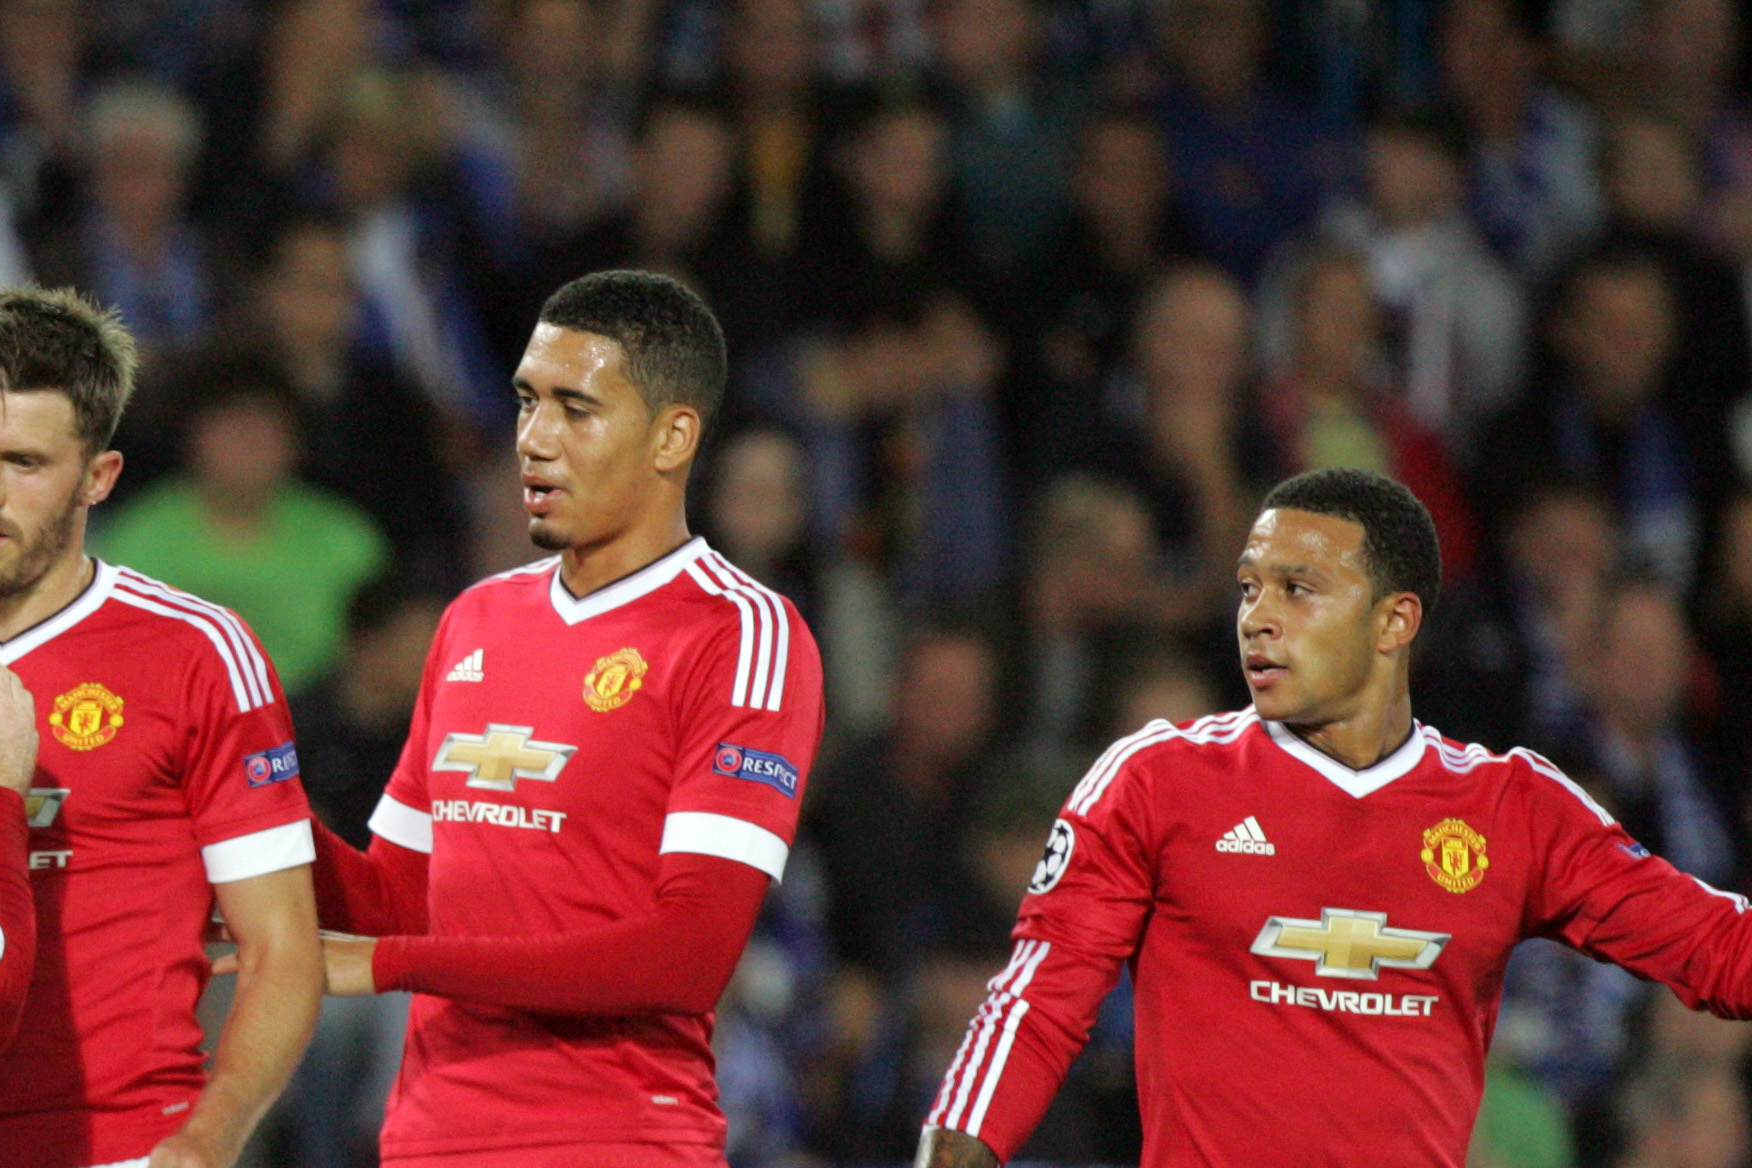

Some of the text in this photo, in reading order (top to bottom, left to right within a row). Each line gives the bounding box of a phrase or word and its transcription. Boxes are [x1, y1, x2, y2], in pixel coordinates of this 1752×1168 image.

[432, 799, 568, 834] CHEVROLET
[1215, 839, 1276, 856] adidas
[1437, 872, 1475, 889] UNITED
[1250, 979, 1440, 1017] CHEVROLET
